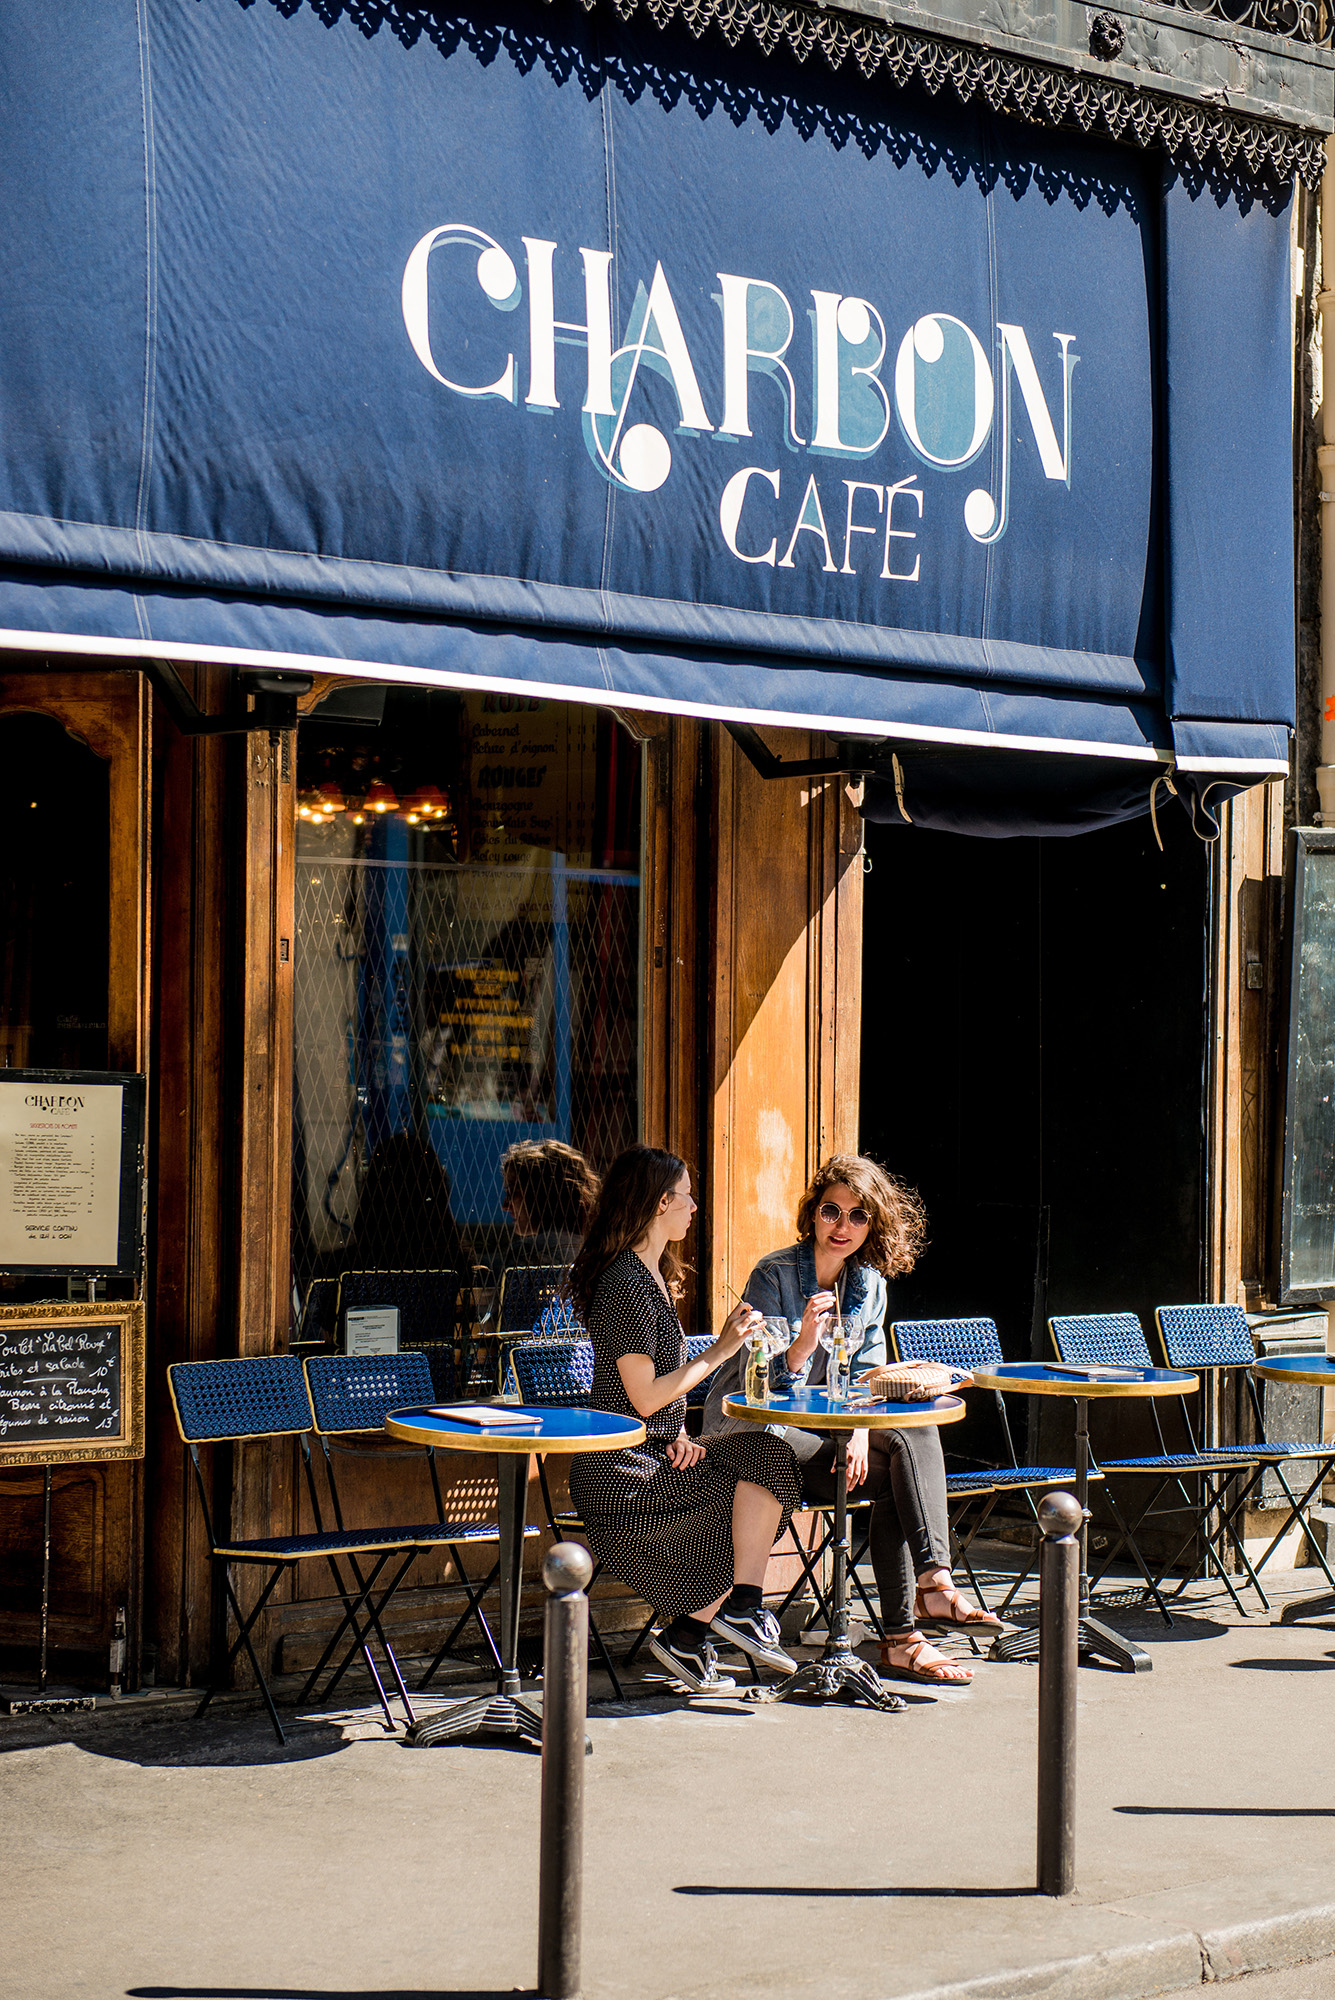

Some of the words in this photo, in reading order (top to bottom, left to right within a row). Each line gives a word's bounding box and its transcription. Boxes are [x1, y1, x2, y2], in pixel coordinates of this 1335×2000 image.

[402, 223, 1078, 544] CHARBON
[719, 467, 924, 582] CAFÉ
[477, 764, 547, 789] ROUGES
[24, 1224, 51, 1232] SERVICE
[27, 1361, 39, 1373] et
[45, 1357, 85, 1373] salade
[0, 1385, 36, 1398] aumon
[39, 1386, 48, 1397] à
[51, 1384, 63, 1396] la
[99, 1397, 112, 1410] et
[0, 1413, 32, 1435] égumes
[37, 1413, 49, 1425] de
